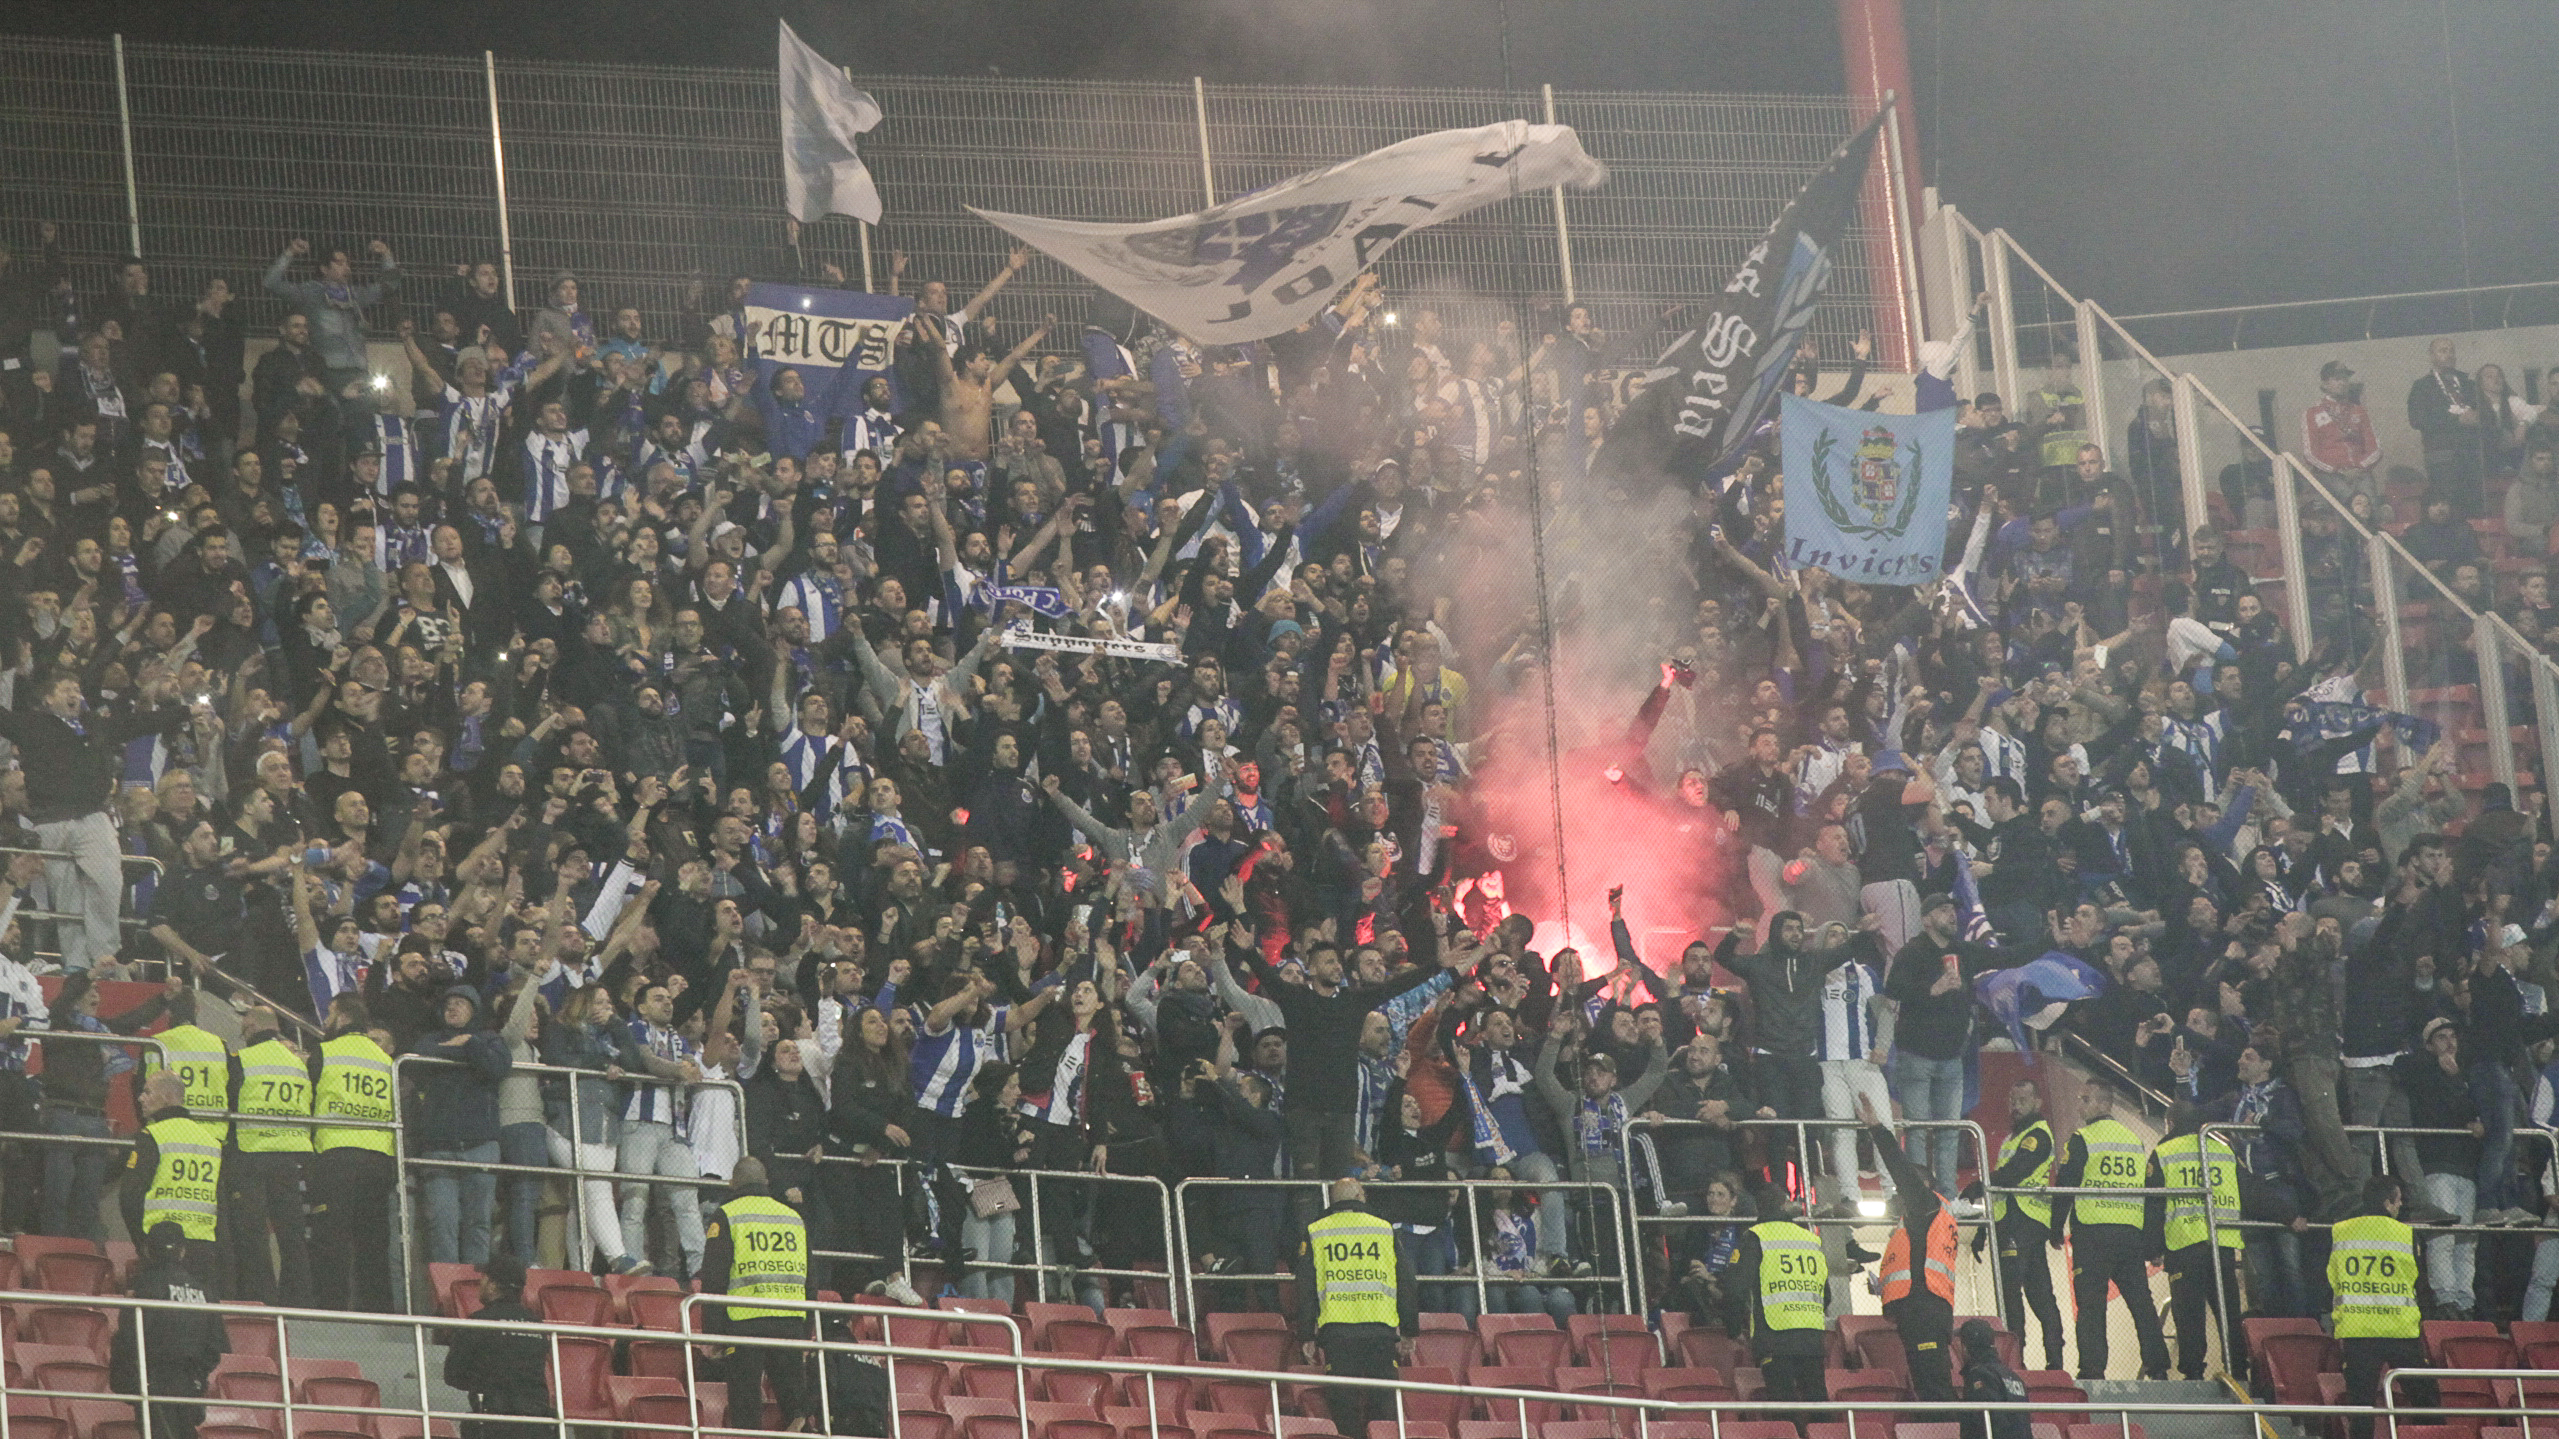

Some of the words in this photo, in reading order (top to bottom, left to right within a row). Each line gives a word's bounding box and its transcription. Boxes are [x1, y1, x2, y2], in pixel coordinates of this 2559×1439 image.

[761, 313, 890, 366] MTS
[181, 1066, 208, 1087] 91
[342, 1072, 387, 1099] 1162
[262, 1081, 304, 1104] 707
[172, 1159, 213, 1182] 902
[2100, 1156, 2136, 1177] 658
[155, 1187, 217, 1202] PROSEGU
[746, 1231, 797, 1251] 1028
[1324, 1242, 1380, 1261] 1044
[1780, 1254, 1817, 1275] 510
[2345, 1256, 2396, 1277] 076
